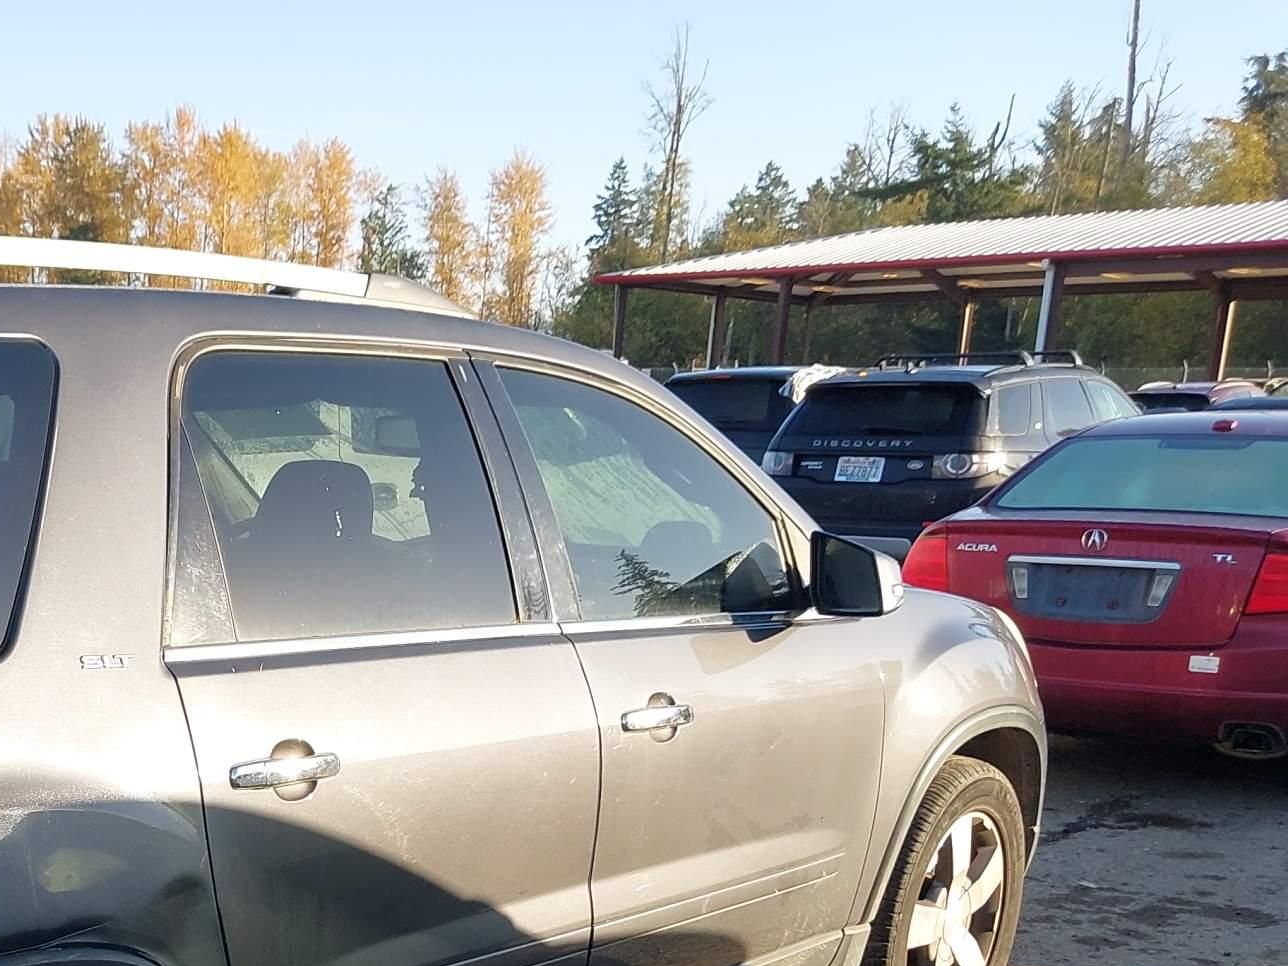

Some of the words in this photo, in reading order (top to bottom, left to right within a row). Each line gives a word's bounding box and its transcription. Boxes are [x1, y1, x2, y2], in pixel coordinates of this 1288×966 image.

[812, 440, 914, 448] DISCOVERY
[956, 543, 999, 552] ACURA
[1212, 553, 1238, 564] TL
[79, 654, 137, 670] SLT
